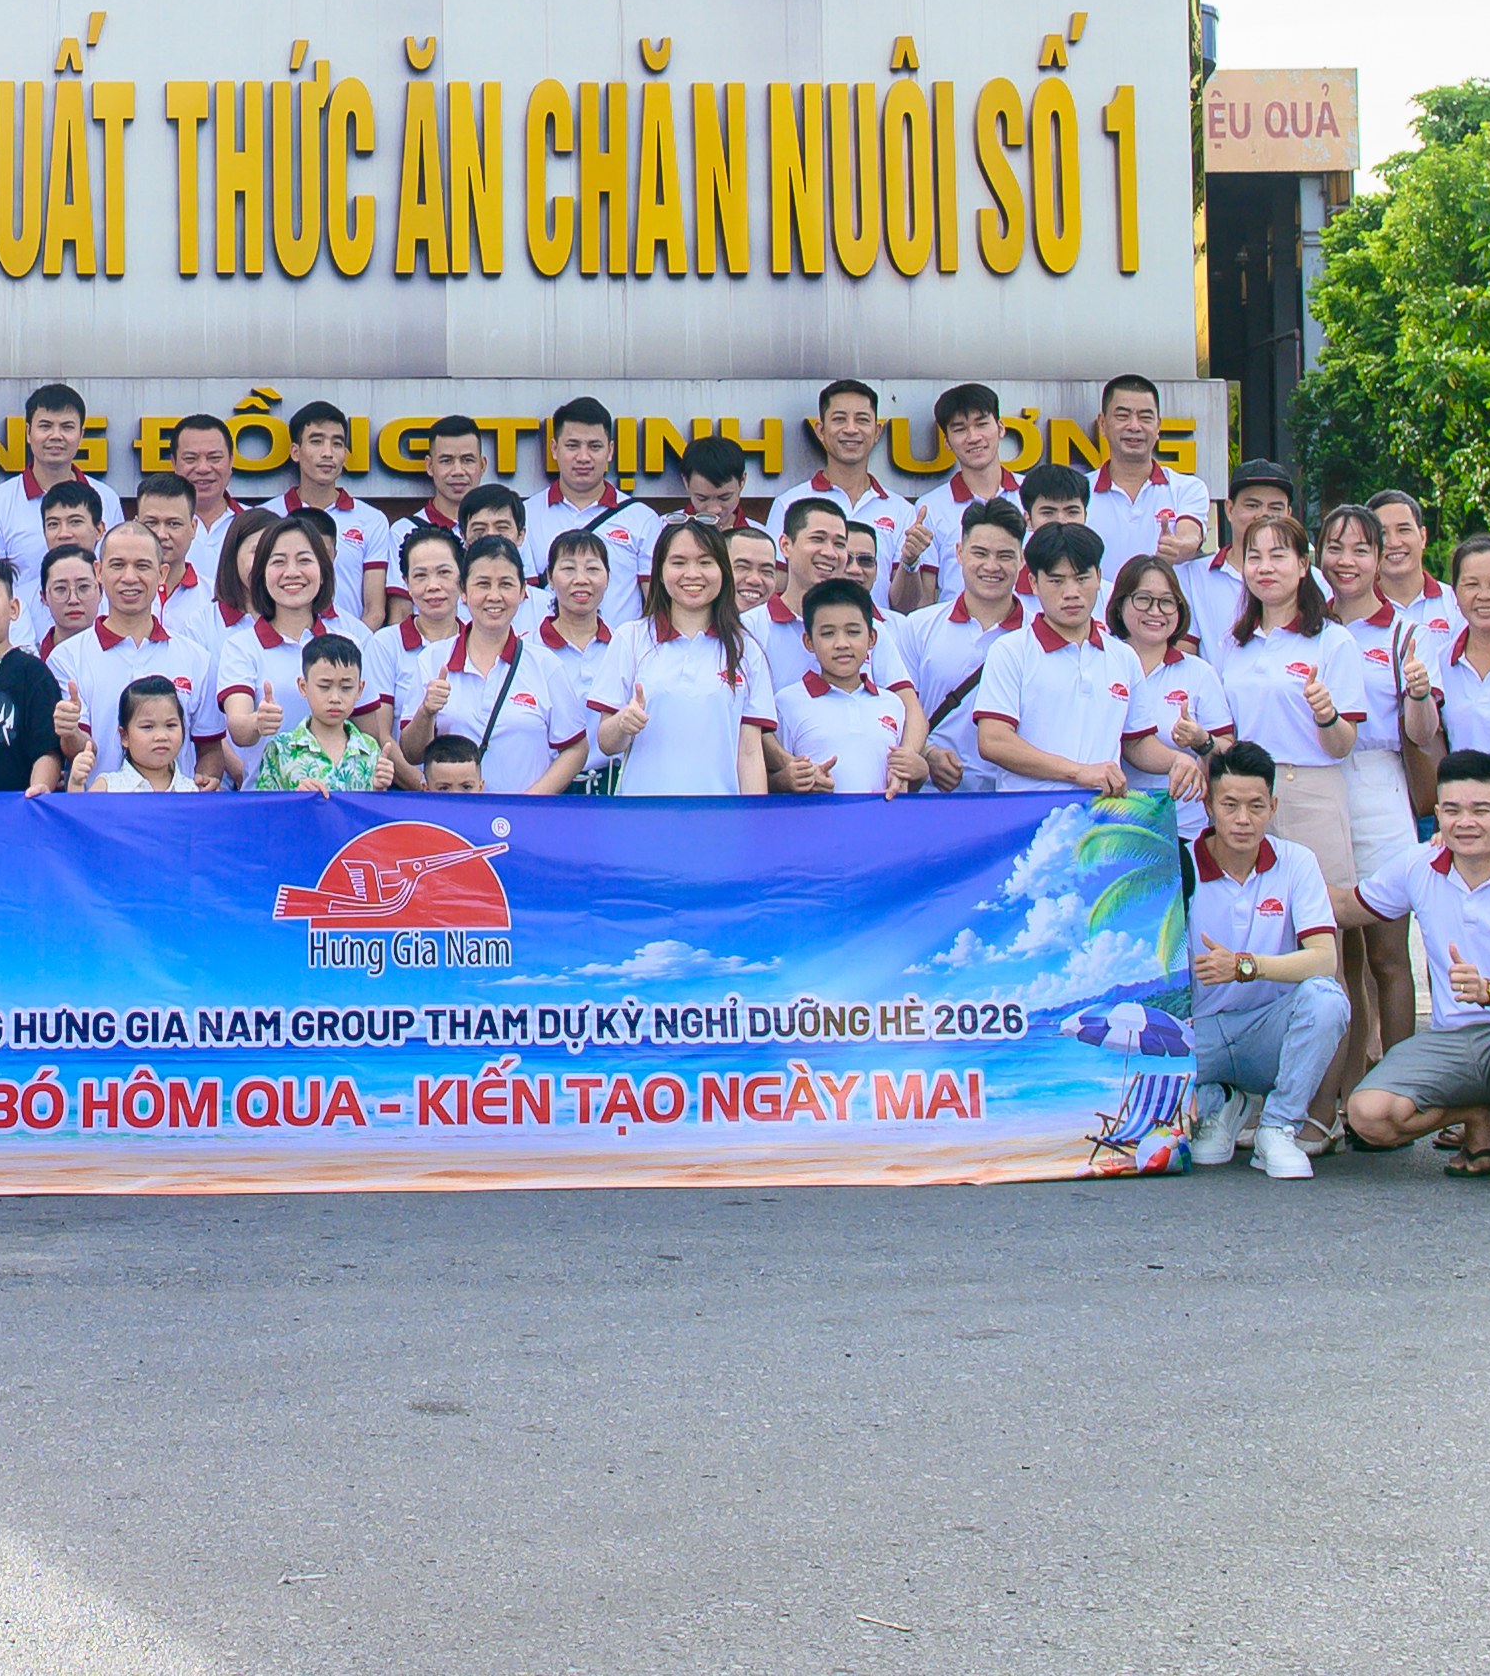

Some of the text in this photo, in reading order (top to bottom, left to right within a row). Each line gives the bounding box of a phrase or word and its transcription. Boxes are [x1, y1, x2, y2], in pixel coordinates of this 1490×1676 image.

[1264, 83, 1340, 139] QUẢ
[166, 40, 376, 277] THỨC
[395, 36, 504, 275] ĂN
[526, 38, 750, 276] CHĂN
[769, 36, 959, 277] NUÔI
[976, 12, 1088, 275] SỐ
[1105, 85, 1140, 272] 1
[310, 931, 510, 973] Hưng Gia Nam
[15, 1006, 116, 1044] HƯNG
[126, 1011, 188, 1043] GIA
[199, 1010, 281, 1042] NAM
[291, 1009, 415, 1041] GROUP
[424, 1008, 529, 1041] THAM
[539, 1004, 590, 1050] DỰ
[597, 1001, 644, 1039] KỲ
[655, 997, 739, 1039] NGHỈ
[749, 998, 870, 1038] DƯỠNG
[880, 998, 920, 1035] HÈ
[934, 1004, 1022, 1035] 2026
[83, 1070, 218, 1128] HÔM
[237, 1081, 366, 1127] QUA
[380, 1104, 400, 1113] -
[419, 1059, 549, 1125] KIẾN
[566, 1077, 684, 1135] TẠO
[703, 1064, 859, 1121] NGÀY
[875, 1074, 981, 1119] MAI
